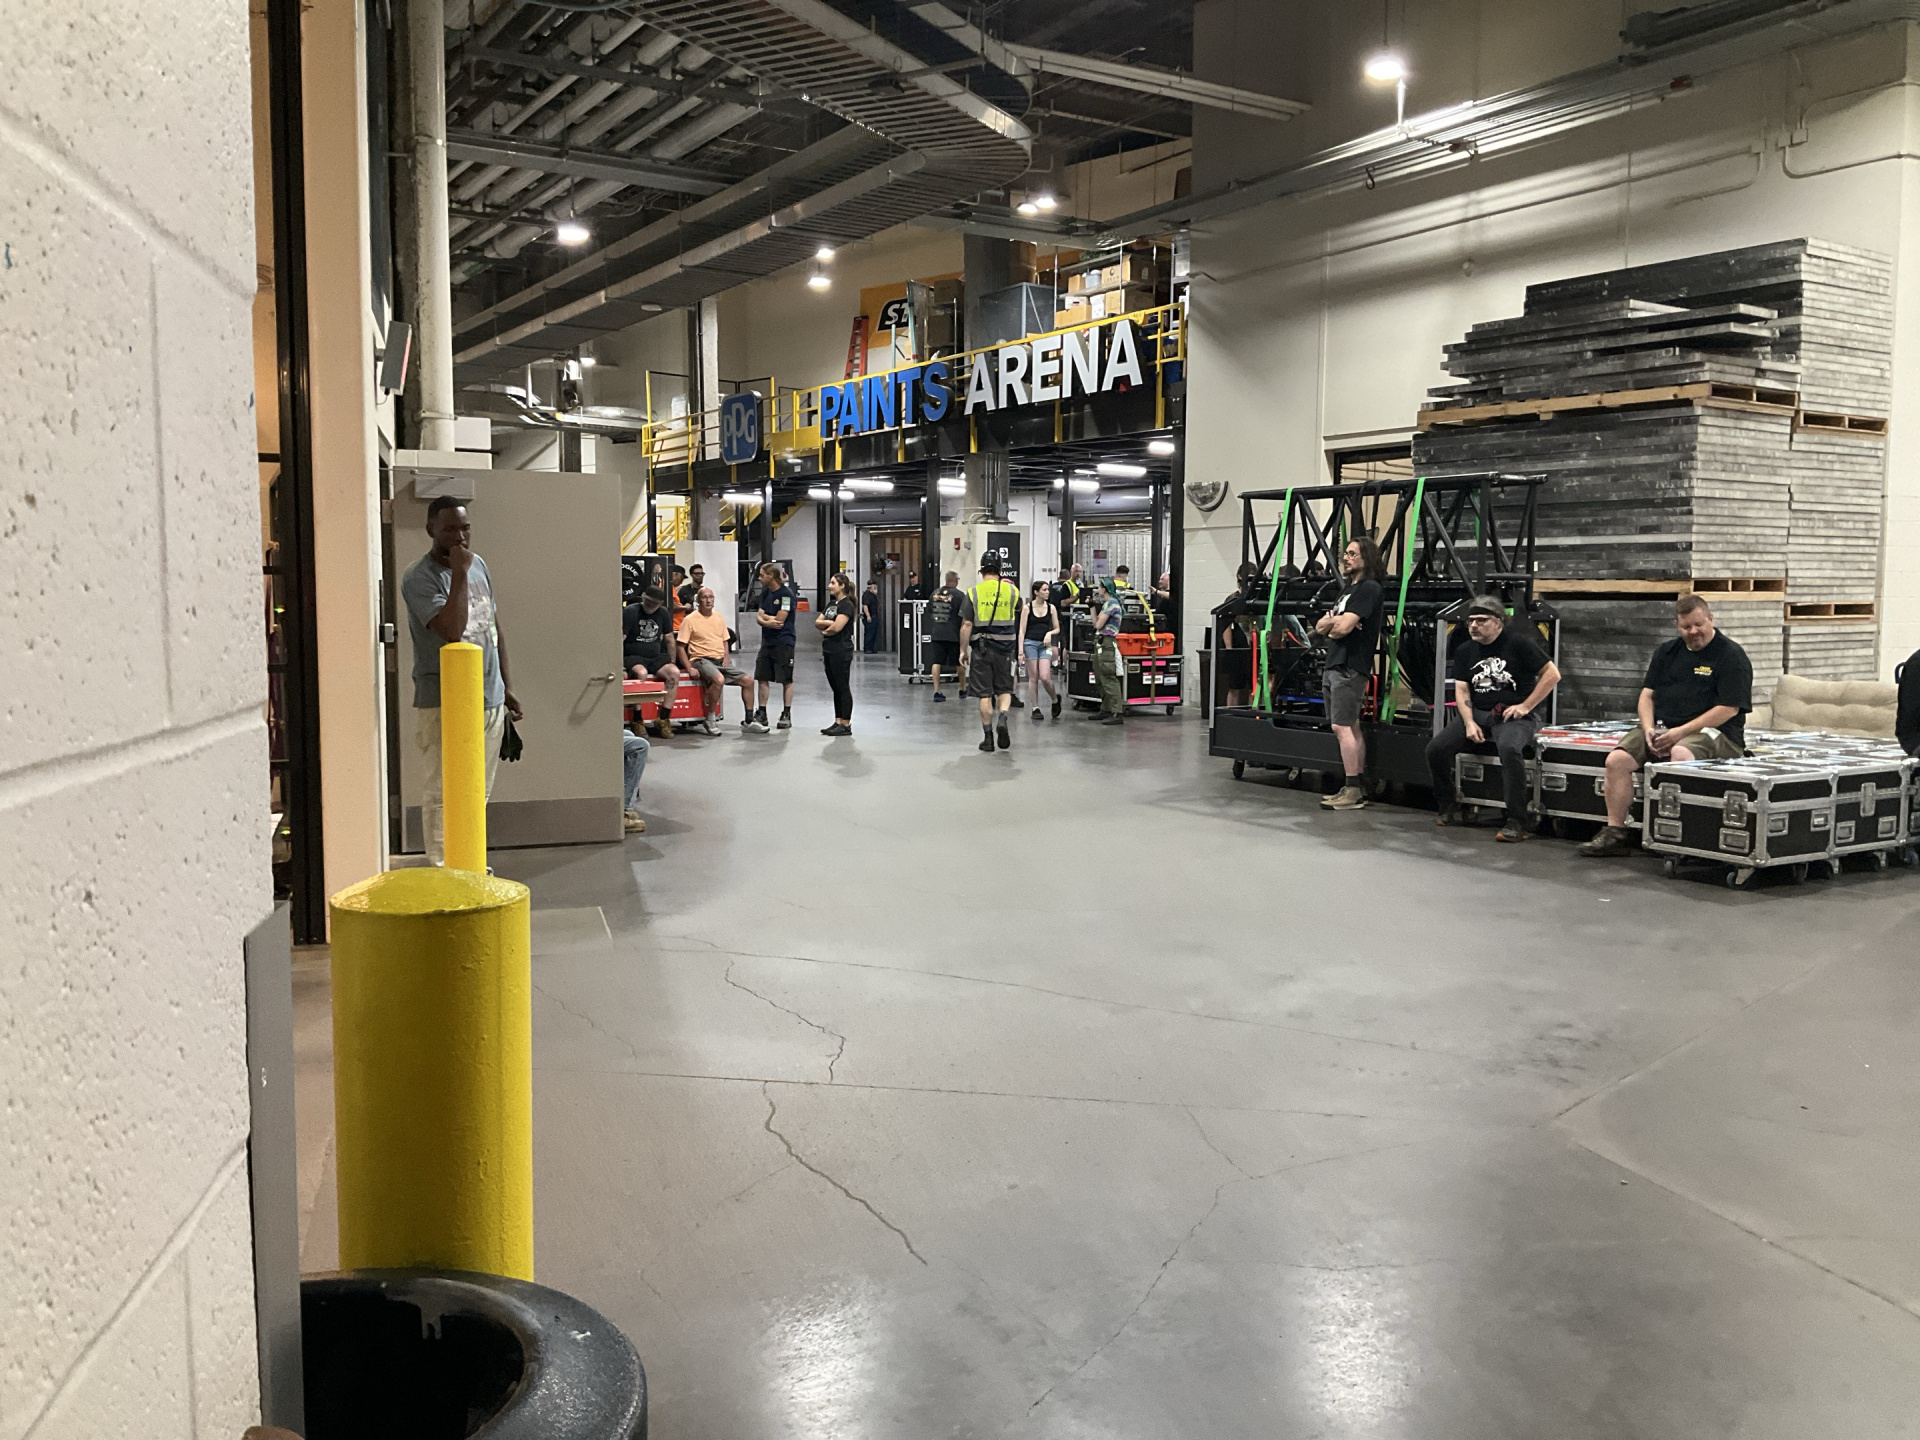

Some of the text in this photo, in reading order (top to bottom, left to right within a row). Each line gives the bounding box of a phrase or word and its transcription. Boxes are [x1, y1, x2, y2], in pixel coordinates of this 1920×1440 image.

[723, 319, 1144, 456] PPG PAINTS ARENA
[1094, 493, 1101, 504] 2
[621, 563, 640, 577] OGUE
